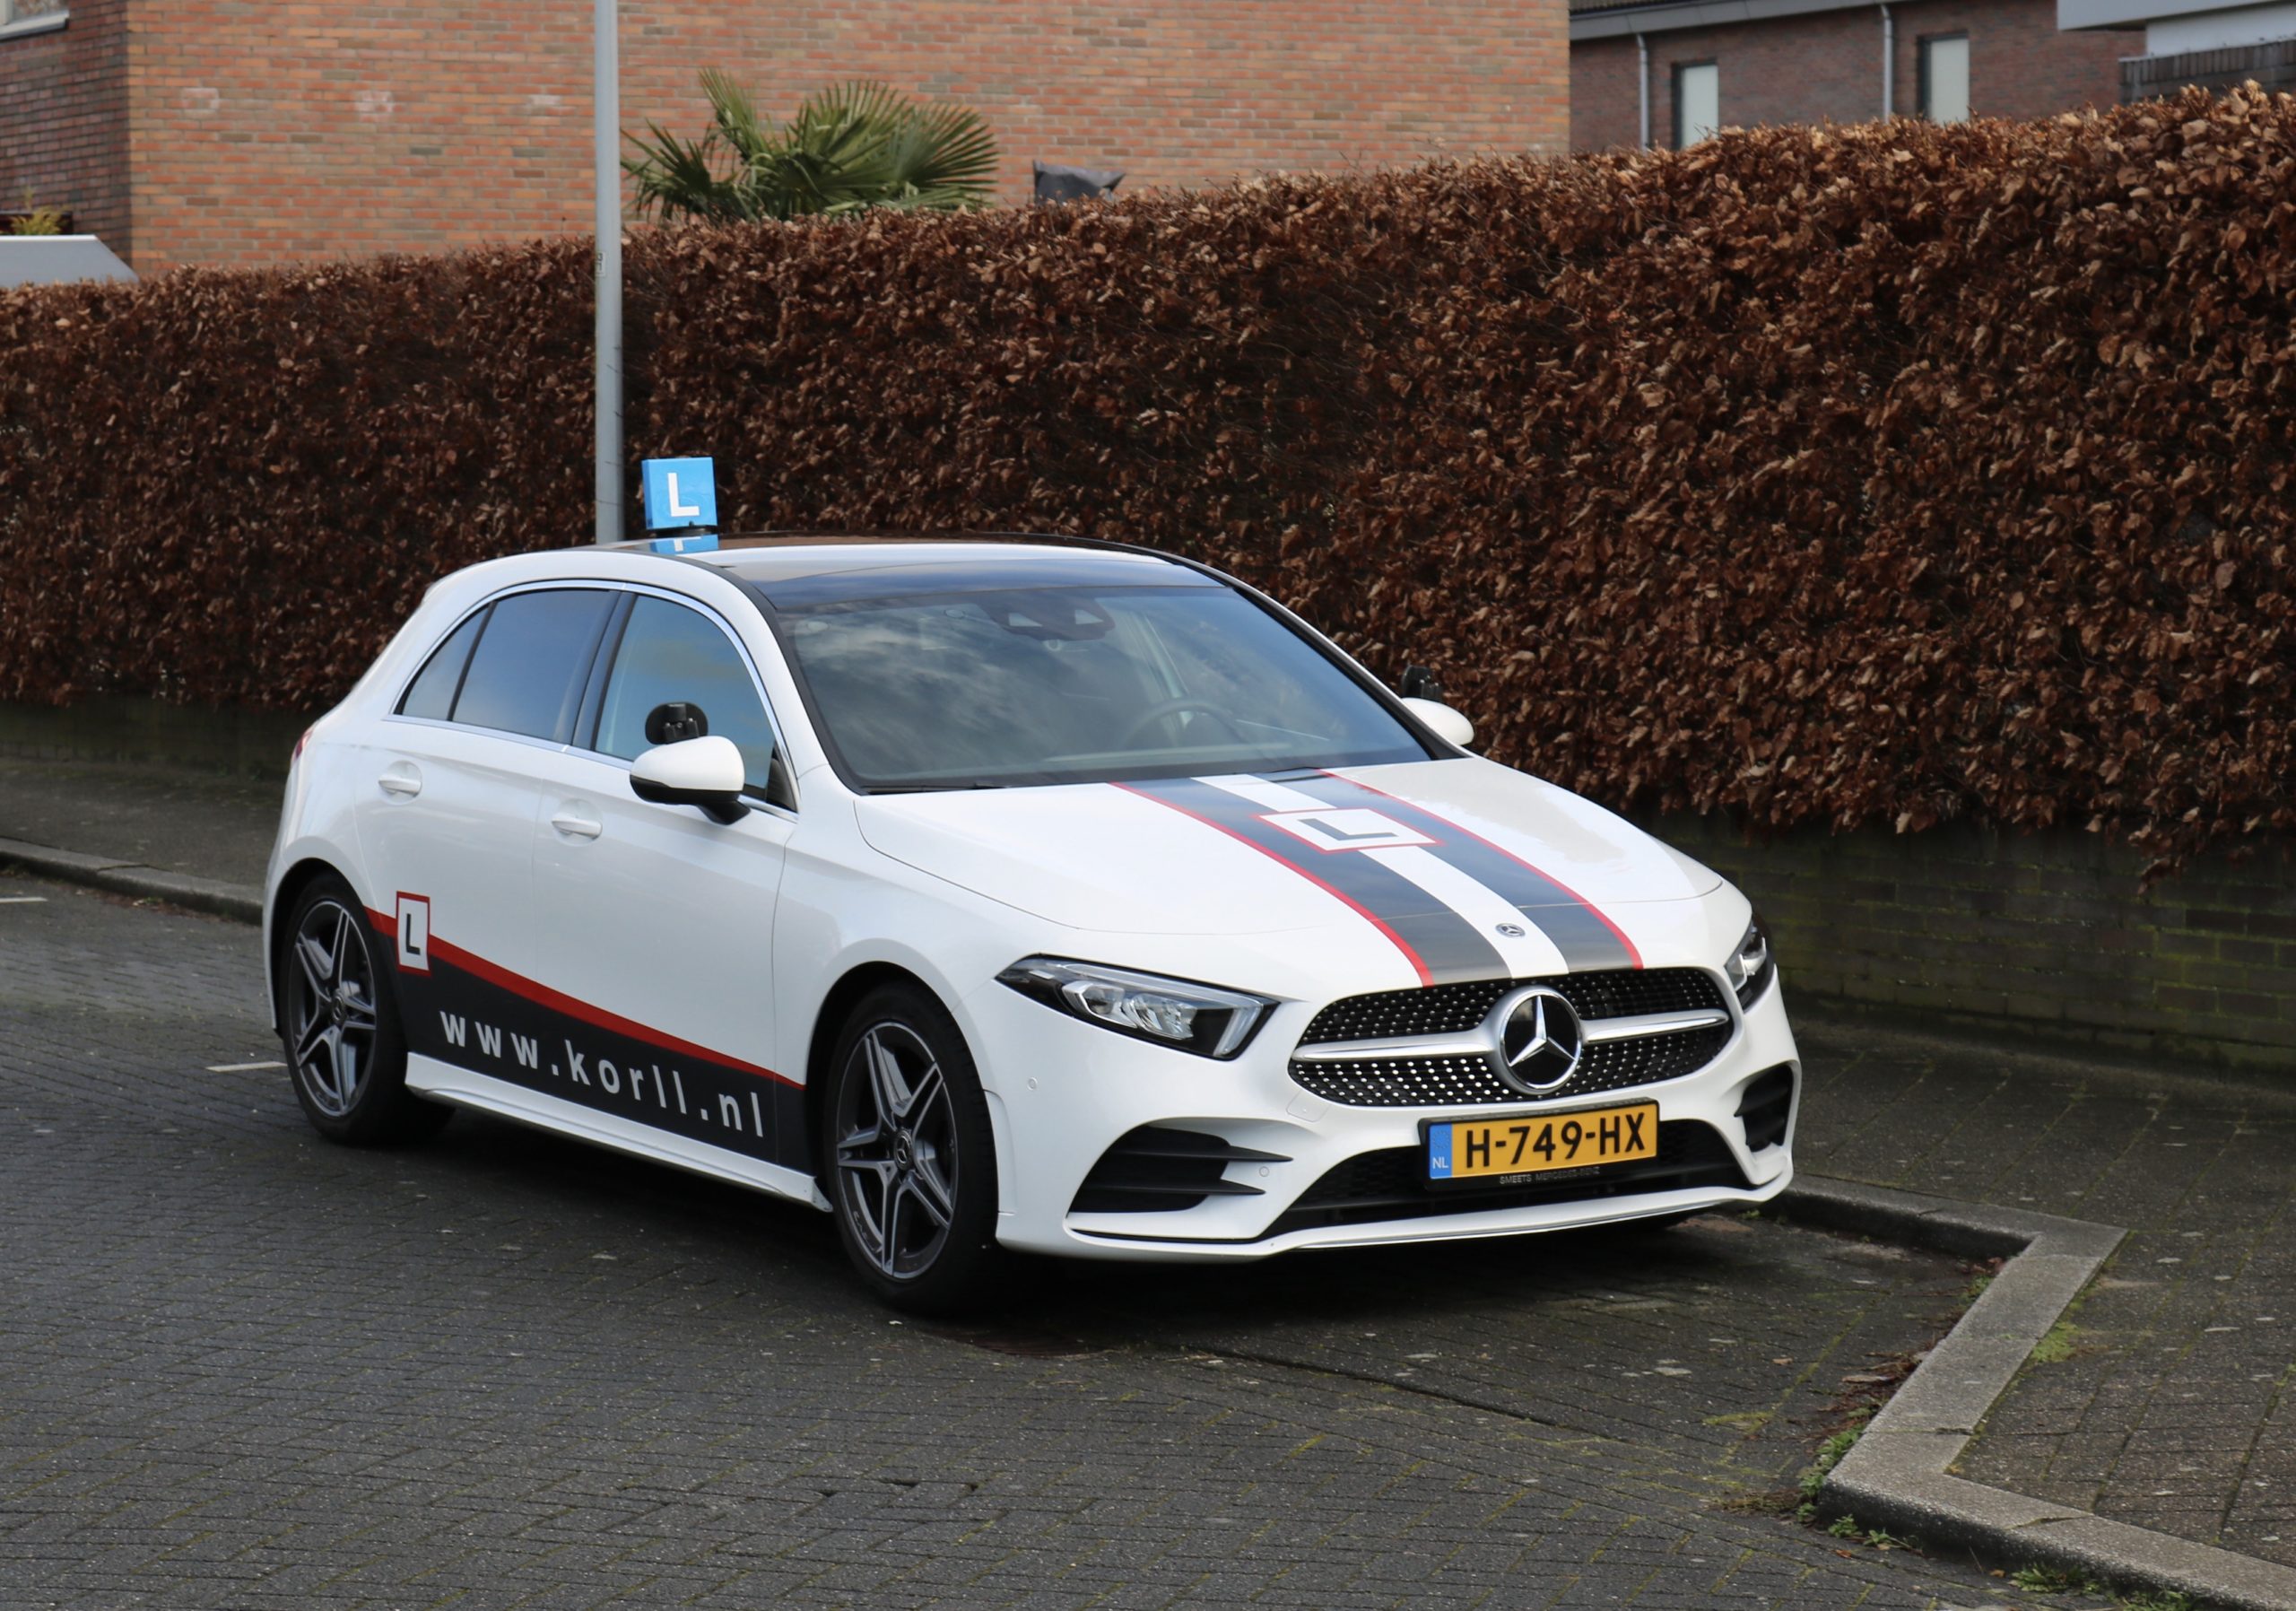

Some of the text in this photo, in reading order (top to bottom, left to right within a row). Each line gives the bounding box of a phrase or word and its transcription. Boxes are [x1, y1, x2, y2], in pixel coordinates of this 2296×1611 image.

[667, 472, 700, 518] L
[1297, 817, 1400, 841] L
[405, 912, 422, 956] L
[439, 1010, 764, 1138] www.korll.nl
[1465, 1111, 1646, 1169] H-749-HX
[1432, 1156, 1449, 1170] NL
[1499, 1173, 1533, 1185] SMEETS
